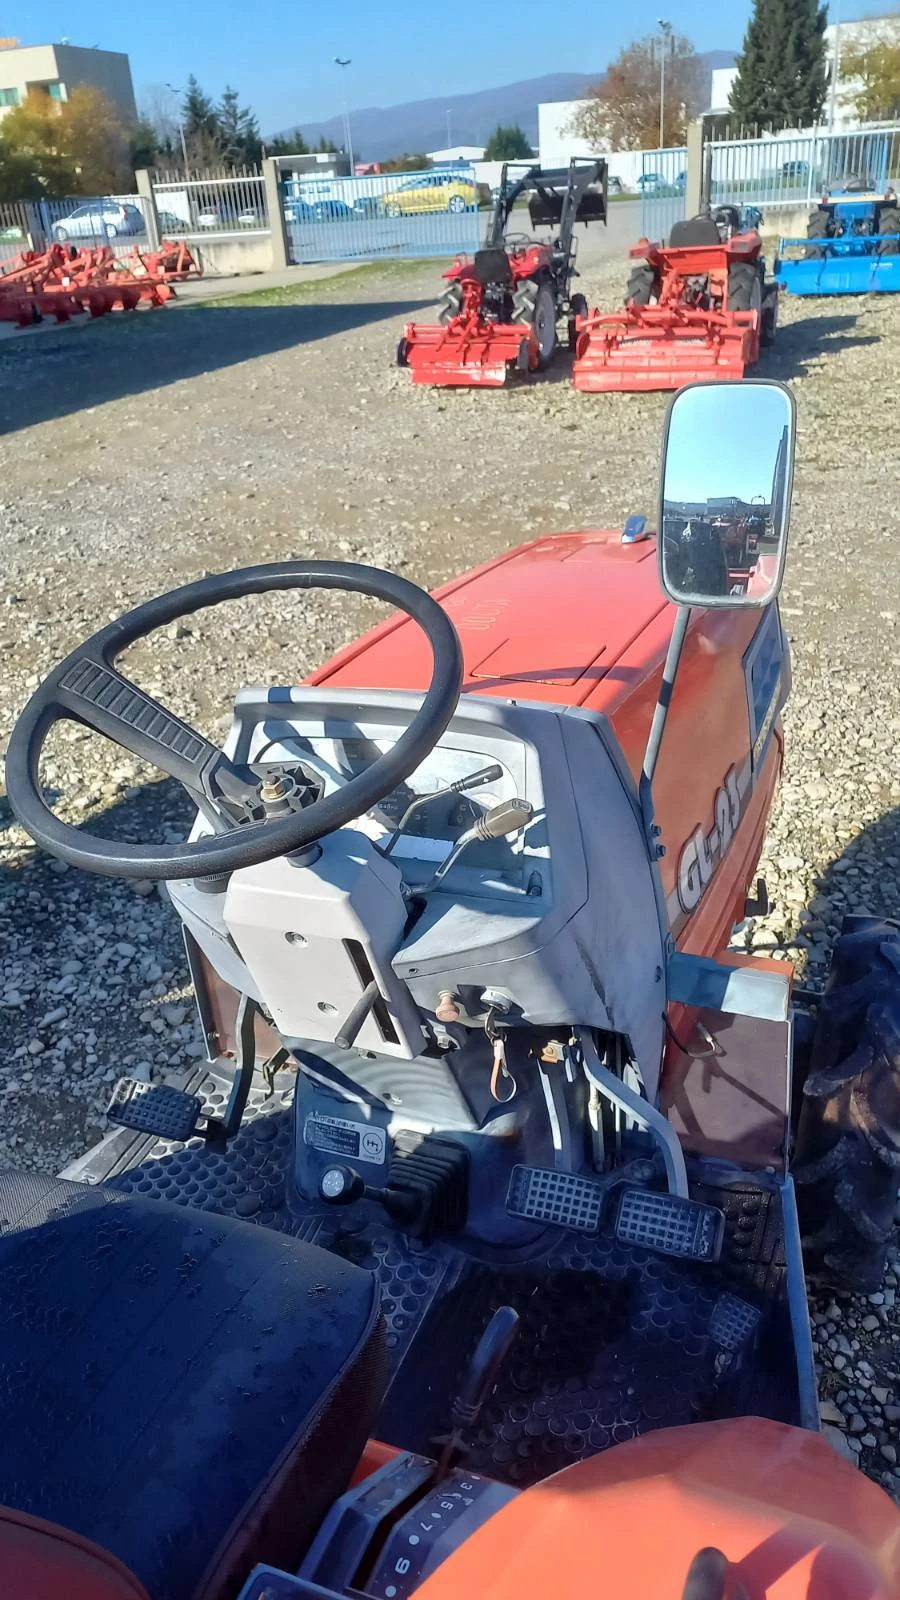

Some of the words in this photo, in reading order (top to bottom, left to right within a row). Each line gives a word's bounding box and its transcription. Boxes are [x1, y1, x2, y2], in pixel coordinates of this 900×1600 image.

[460, 1482, 473, 1490] 3
[440, 1501, 454, 1510] 5
[420, 1522, 433, 1531] 7
